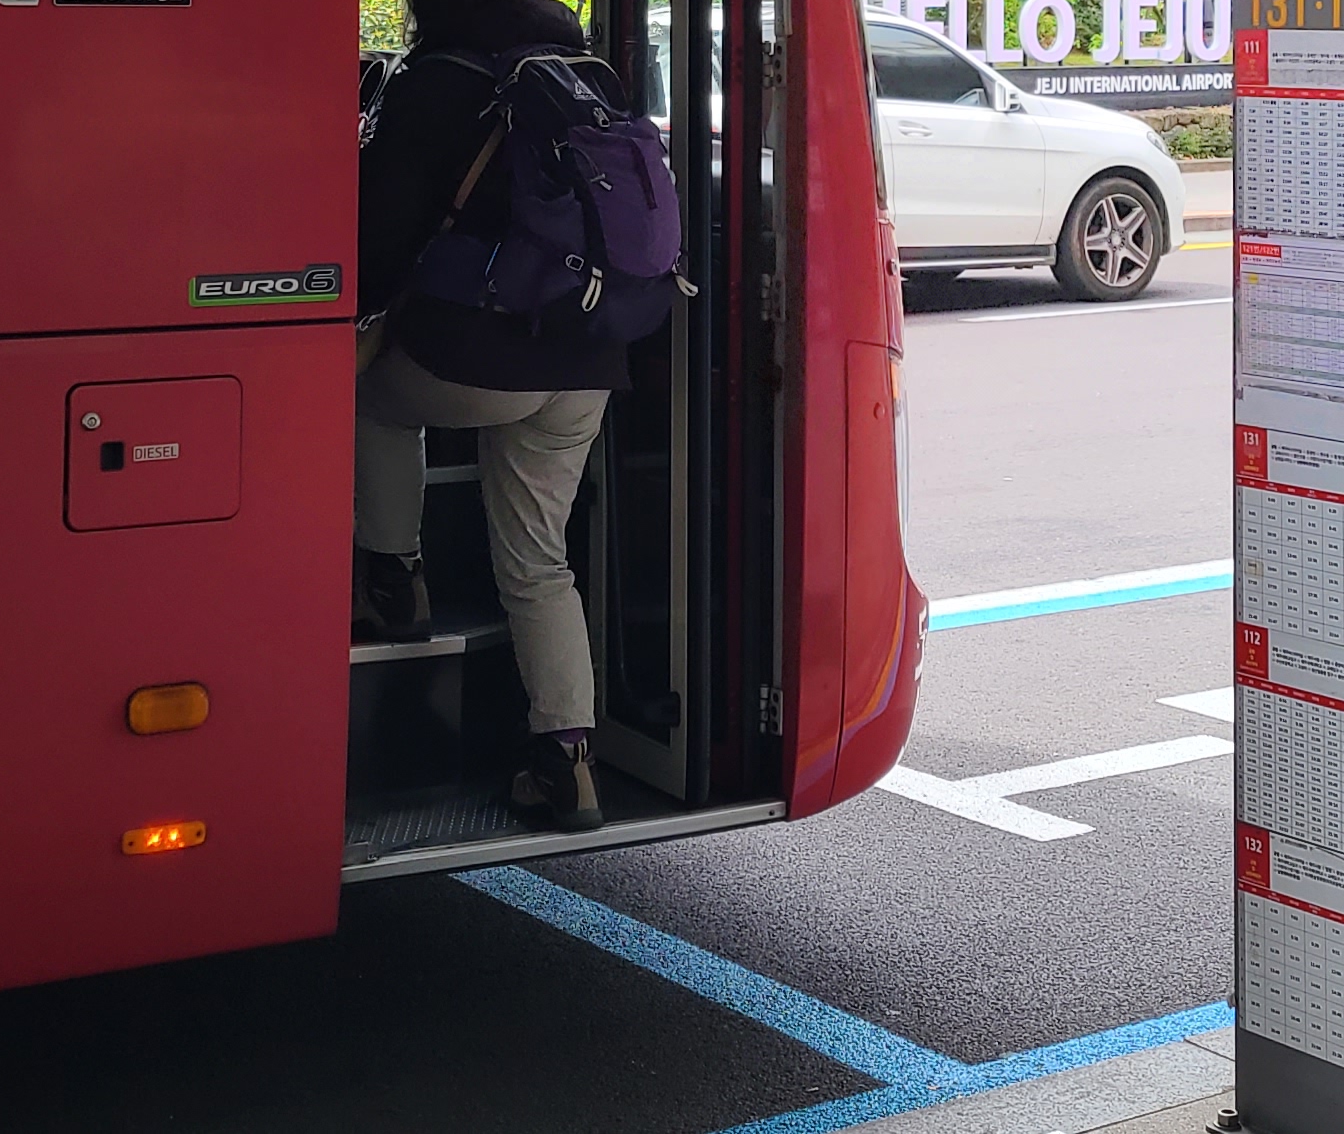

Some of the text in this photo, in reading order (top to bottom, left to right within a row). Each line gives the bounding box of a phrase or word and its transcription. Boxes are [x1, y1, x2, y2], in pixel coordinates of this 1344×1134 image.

[1244, 40, 1260, 54] 111
[1034, 72, 1234, 96] JEJU INTERNATIONAL AIRPOR
[1242, 431, 1259, 446] 131
[134, 445, 178, 460] DIESEL
[1243, 629, 1261, 646] 112
[1244, 835, 1263, 854] 132
